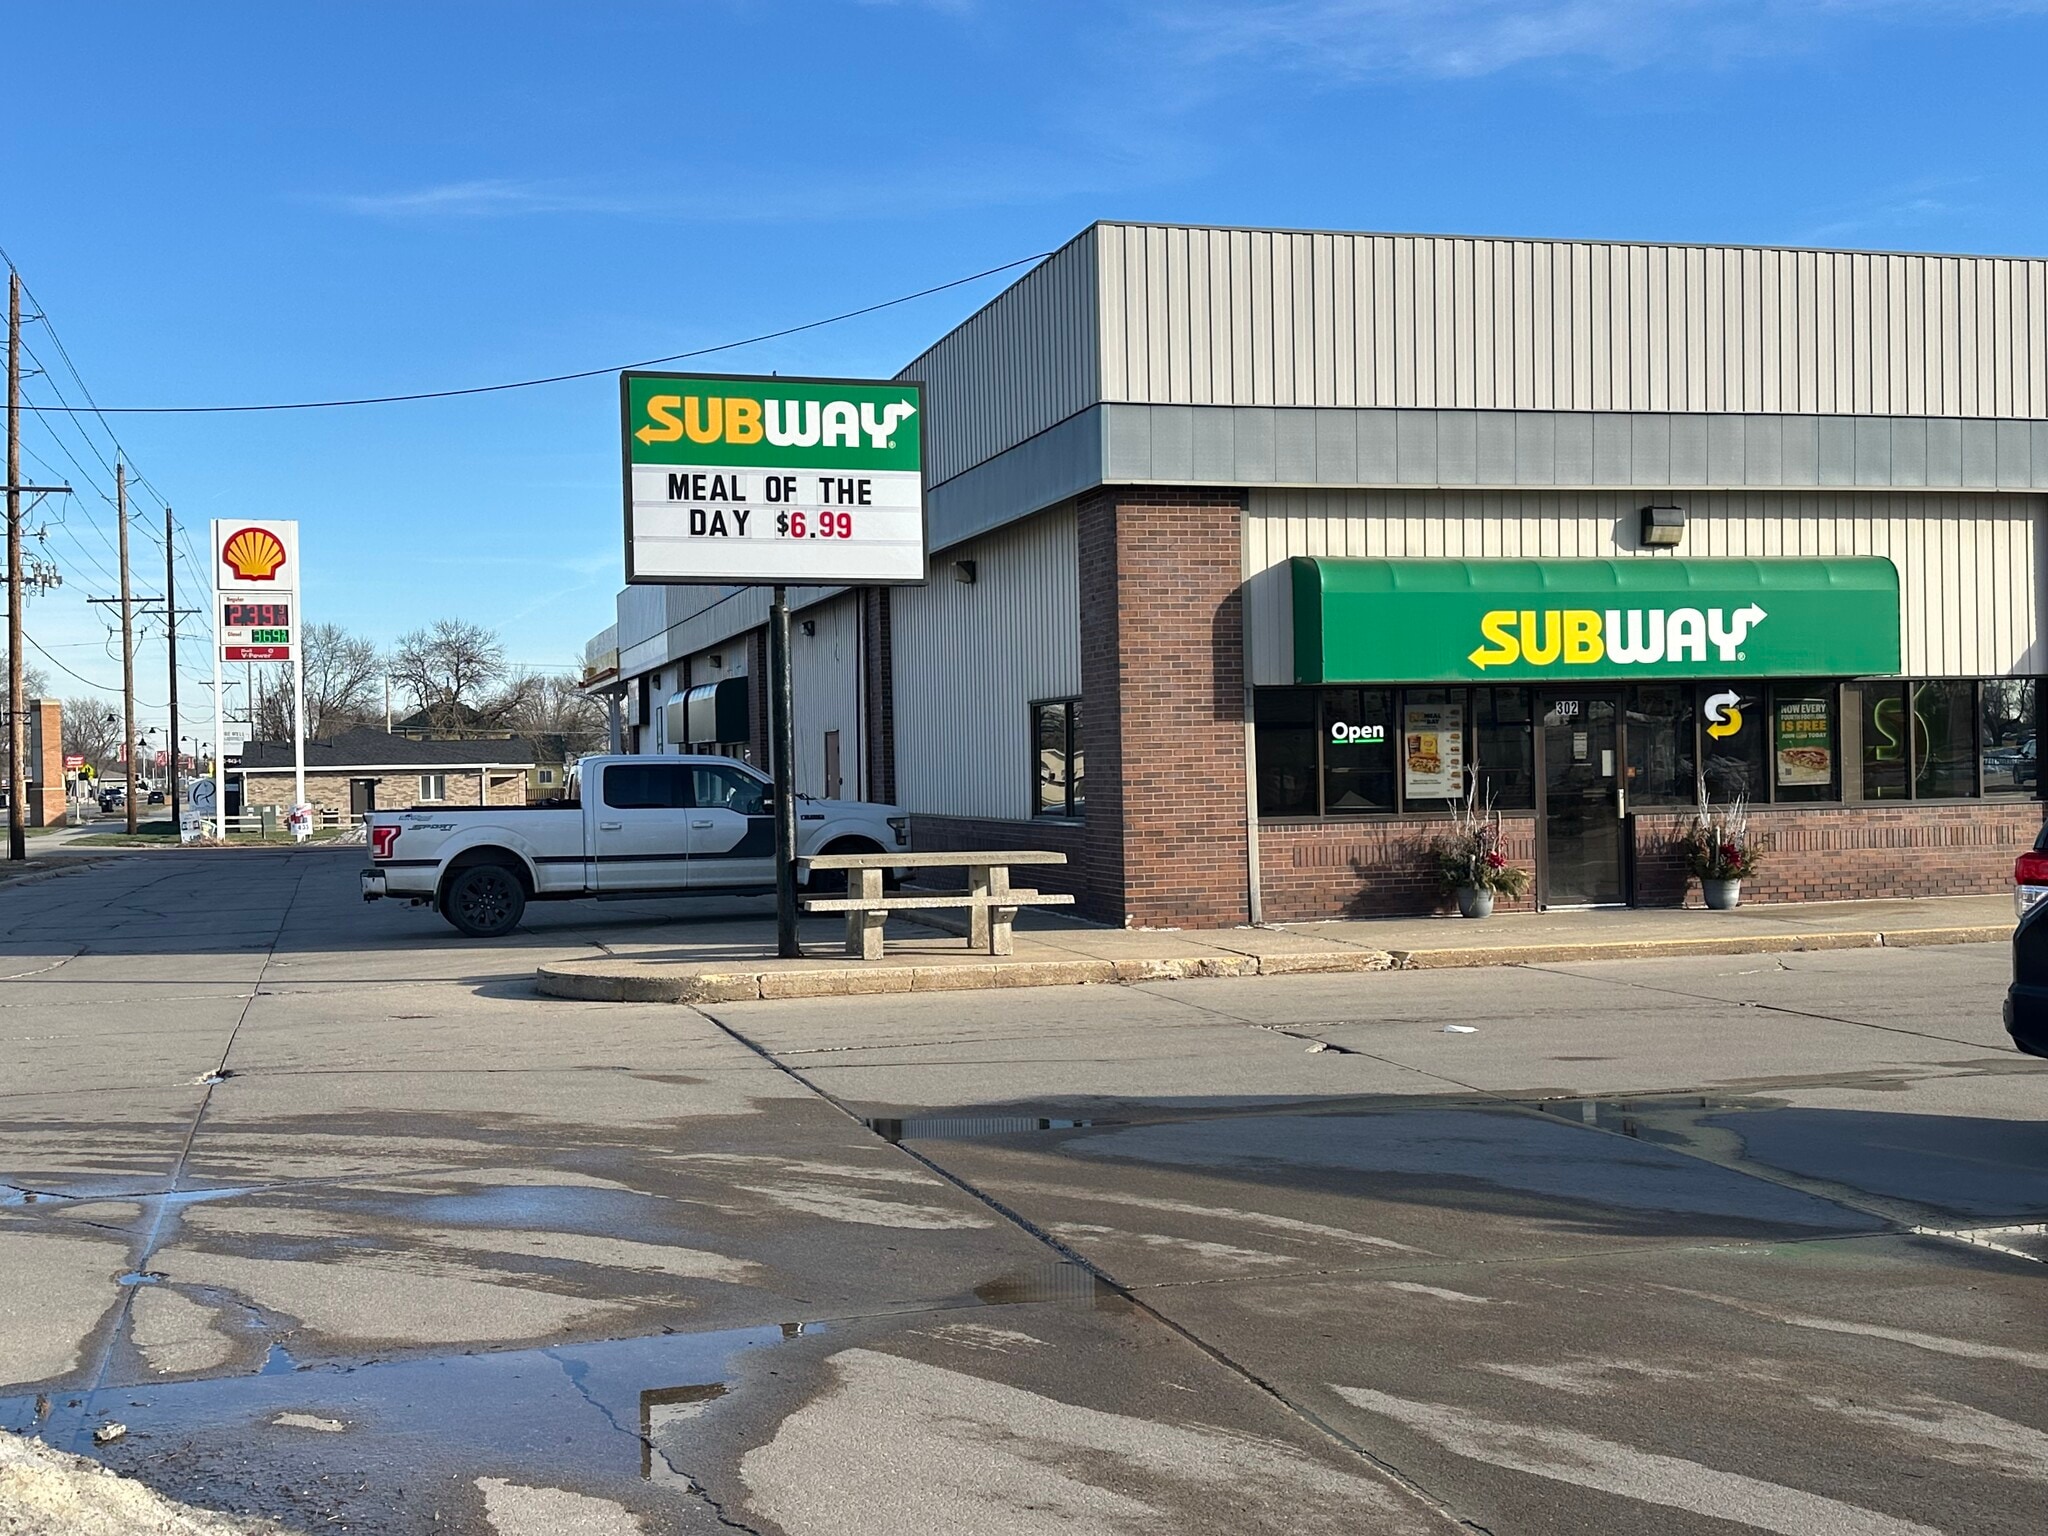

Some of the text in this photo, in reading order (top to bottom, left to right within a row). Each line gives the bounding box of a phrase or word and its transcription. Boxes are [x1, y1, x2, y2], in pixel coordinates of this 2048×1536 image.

[635, 395, 917, 448] SUBWAY
[668, 473, 872, 506] MEAL OF THE
[690, 509, 852, 539] DAY $6.99
[1467, 602, 1768, 671] SUBWAY
[1556, 701, 1578, 714] 302
[1801, 704, 1826, 713] EVERY
[1331, 721, 1385, 744] Open
[1781, 721, 1826, 732] IS FREE
